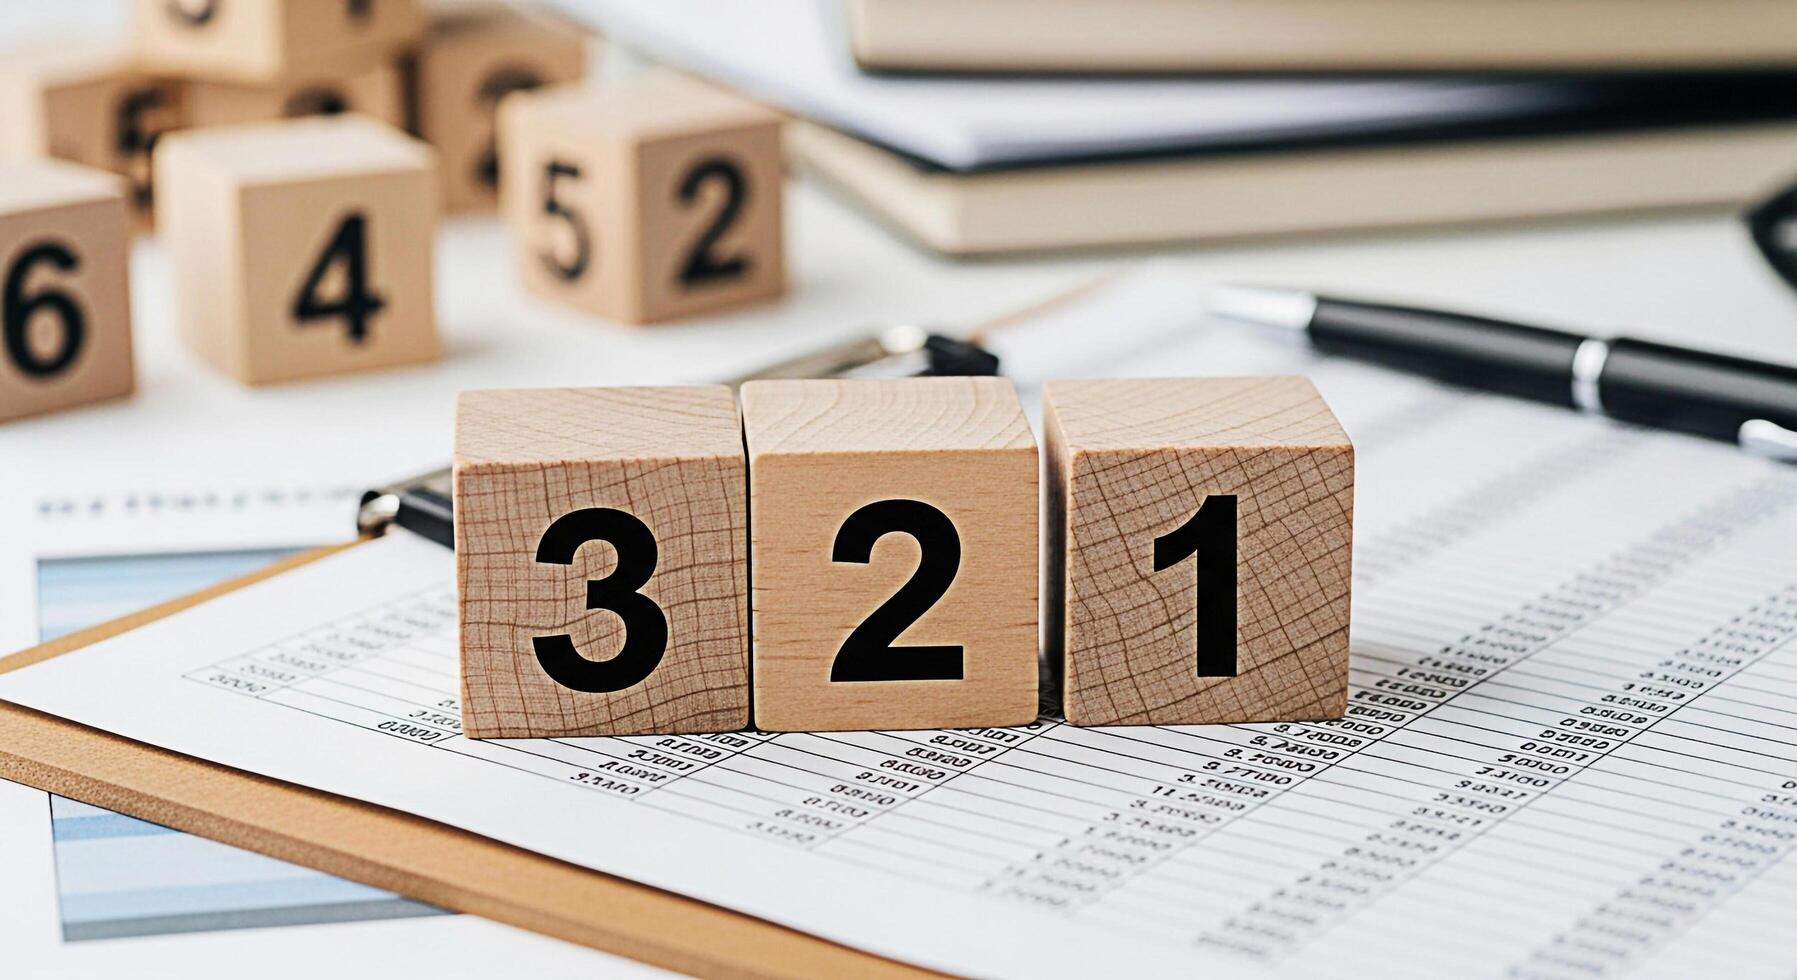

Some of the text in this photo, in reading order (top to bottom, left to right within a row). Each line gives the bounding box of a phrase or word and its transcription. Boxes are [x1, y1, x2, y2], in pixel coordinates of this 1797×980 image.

[289, 210, 387, 345] 4
[540, 157, 592, 286] 5
[672, 150, 758, 295] 2
[0, 239, 88, 383] 6
[533, 508, 668, 693] 3
[831, 500, 963, 682] 2
[1154, 495, 1238, 677] 1
